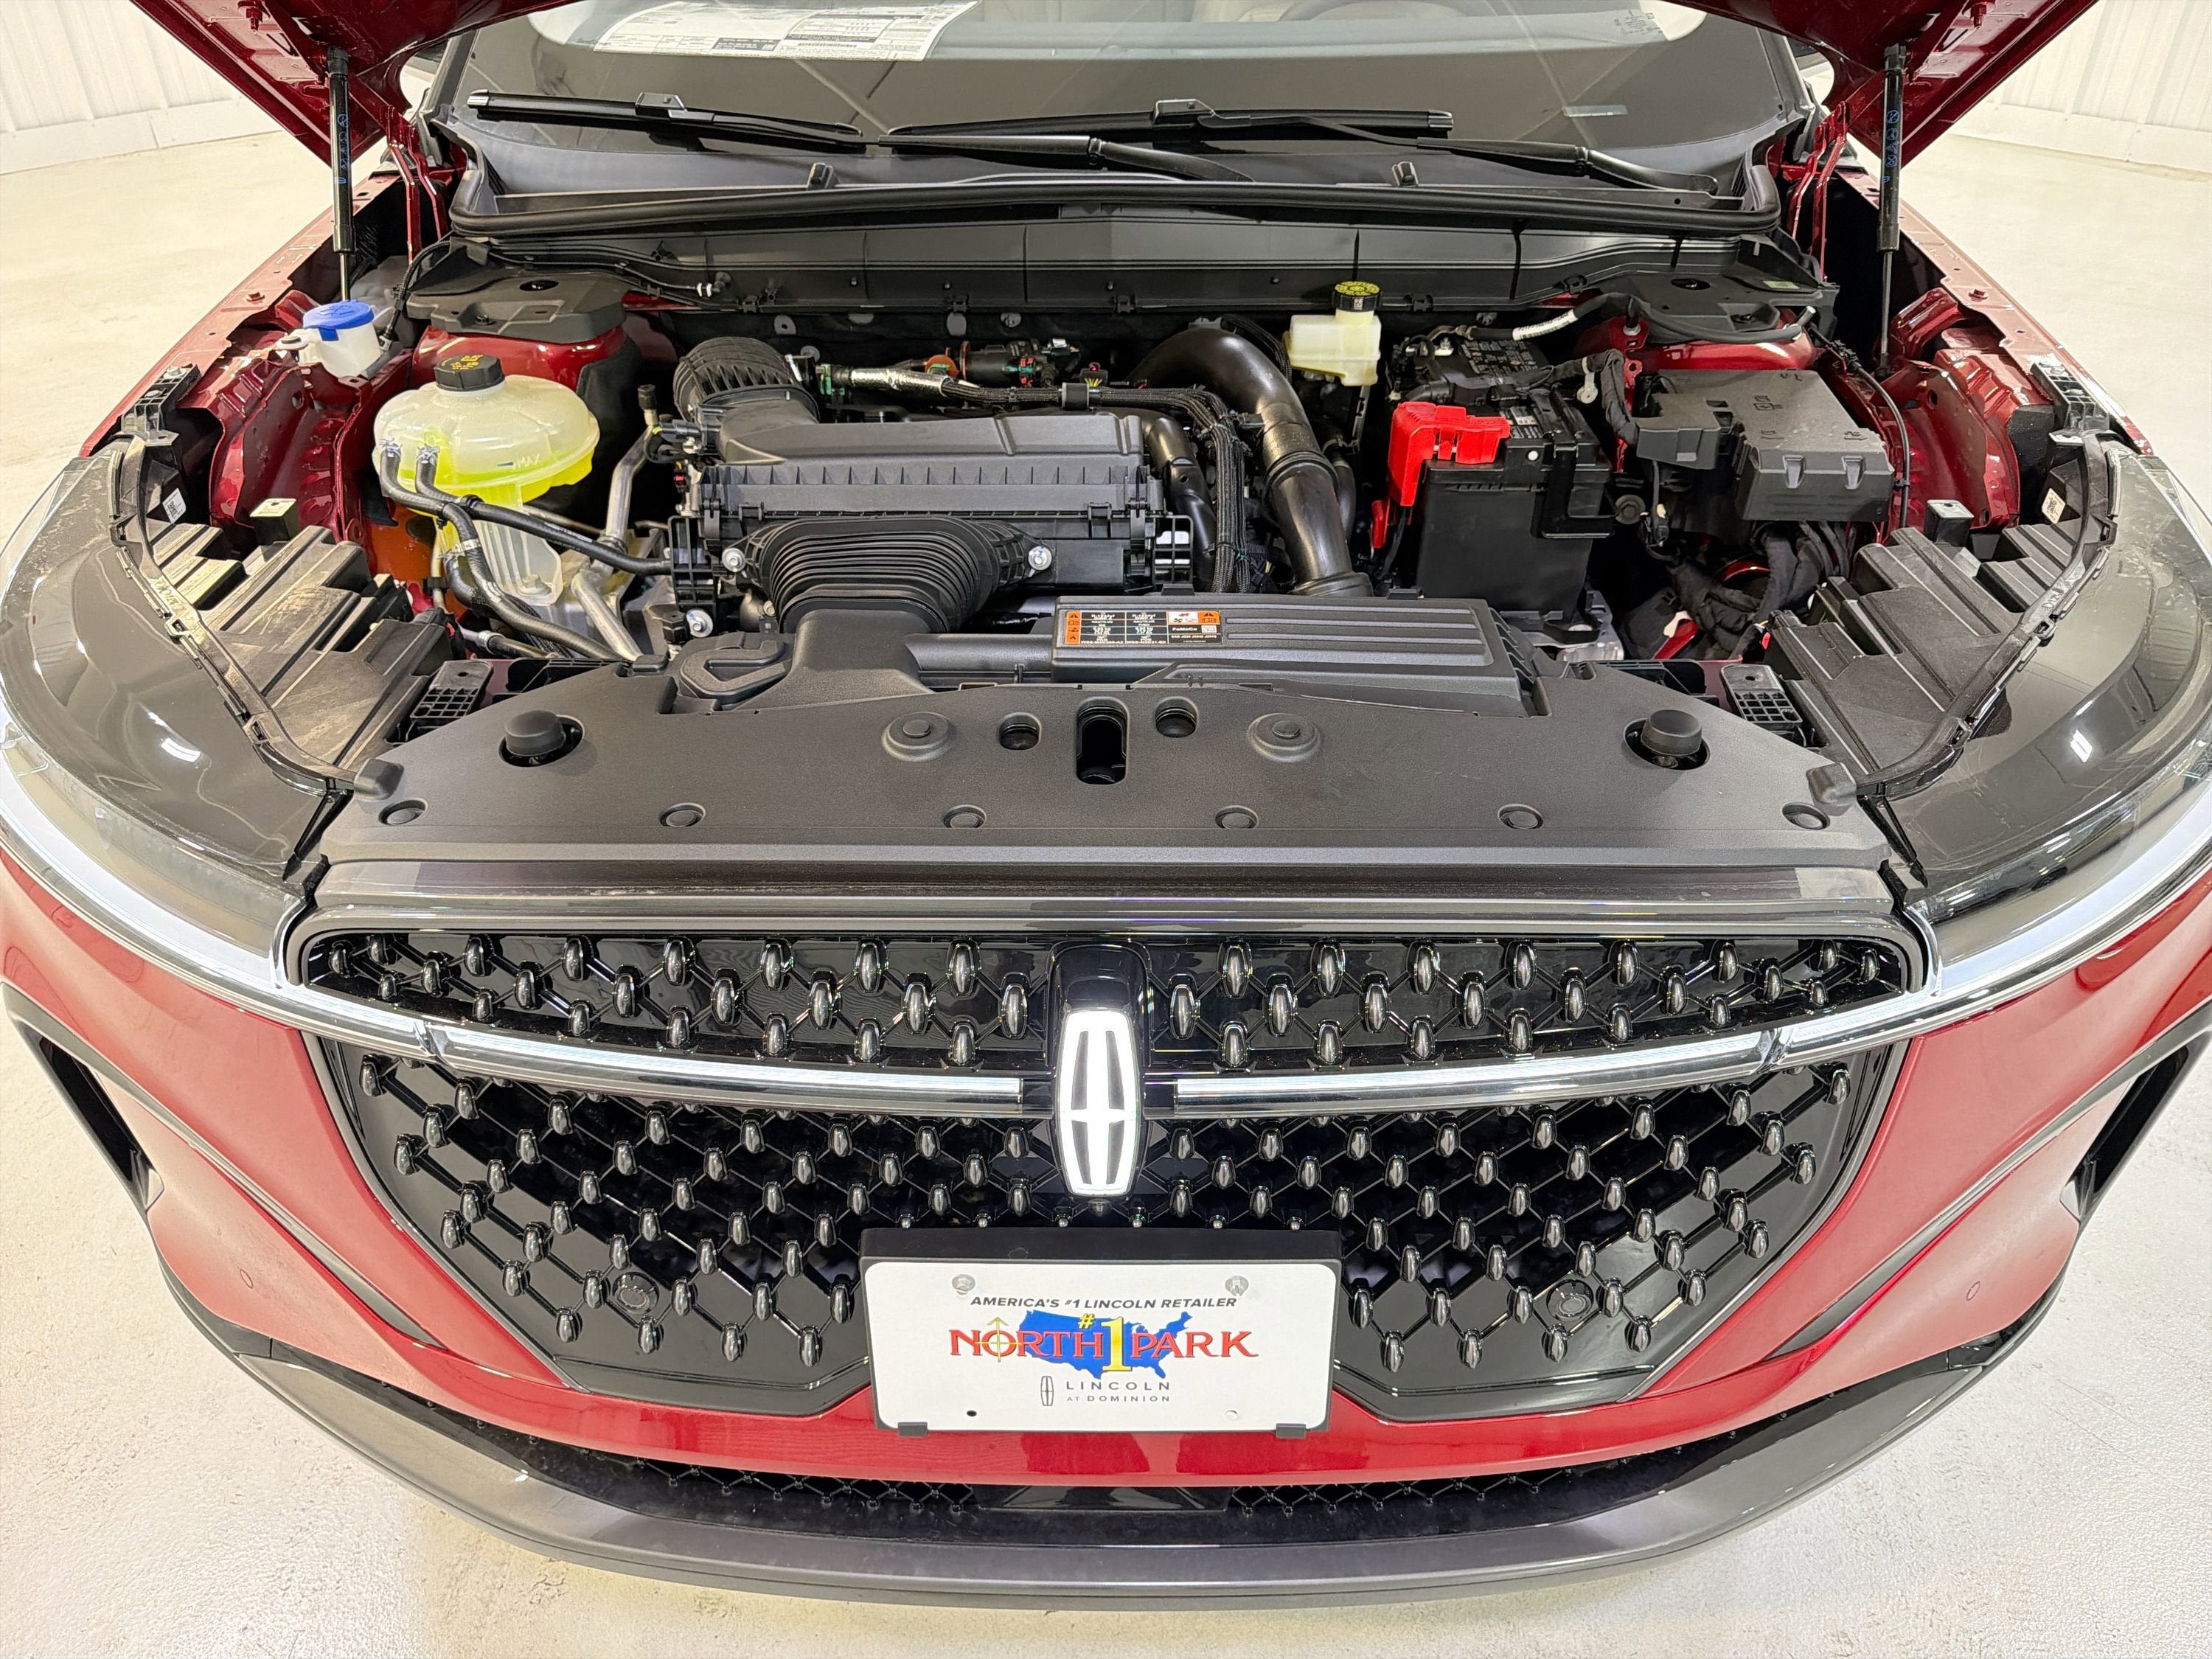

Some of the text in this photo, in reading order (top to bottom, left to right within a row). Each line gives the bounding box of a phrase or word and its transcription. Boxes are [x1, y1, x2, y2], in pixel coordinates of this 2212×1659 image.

[514, 453, 540, 470] MAX
[970, 1296, 1238, 1309] AMERICA'S #1 LINCOLN RETAILER
[948, 1329, 1259, 1359] NORTH PARK
[1065, 1380, 1171, 1391] LINCOLN
[1086, 1394, 1171, 1402] DOMINION
